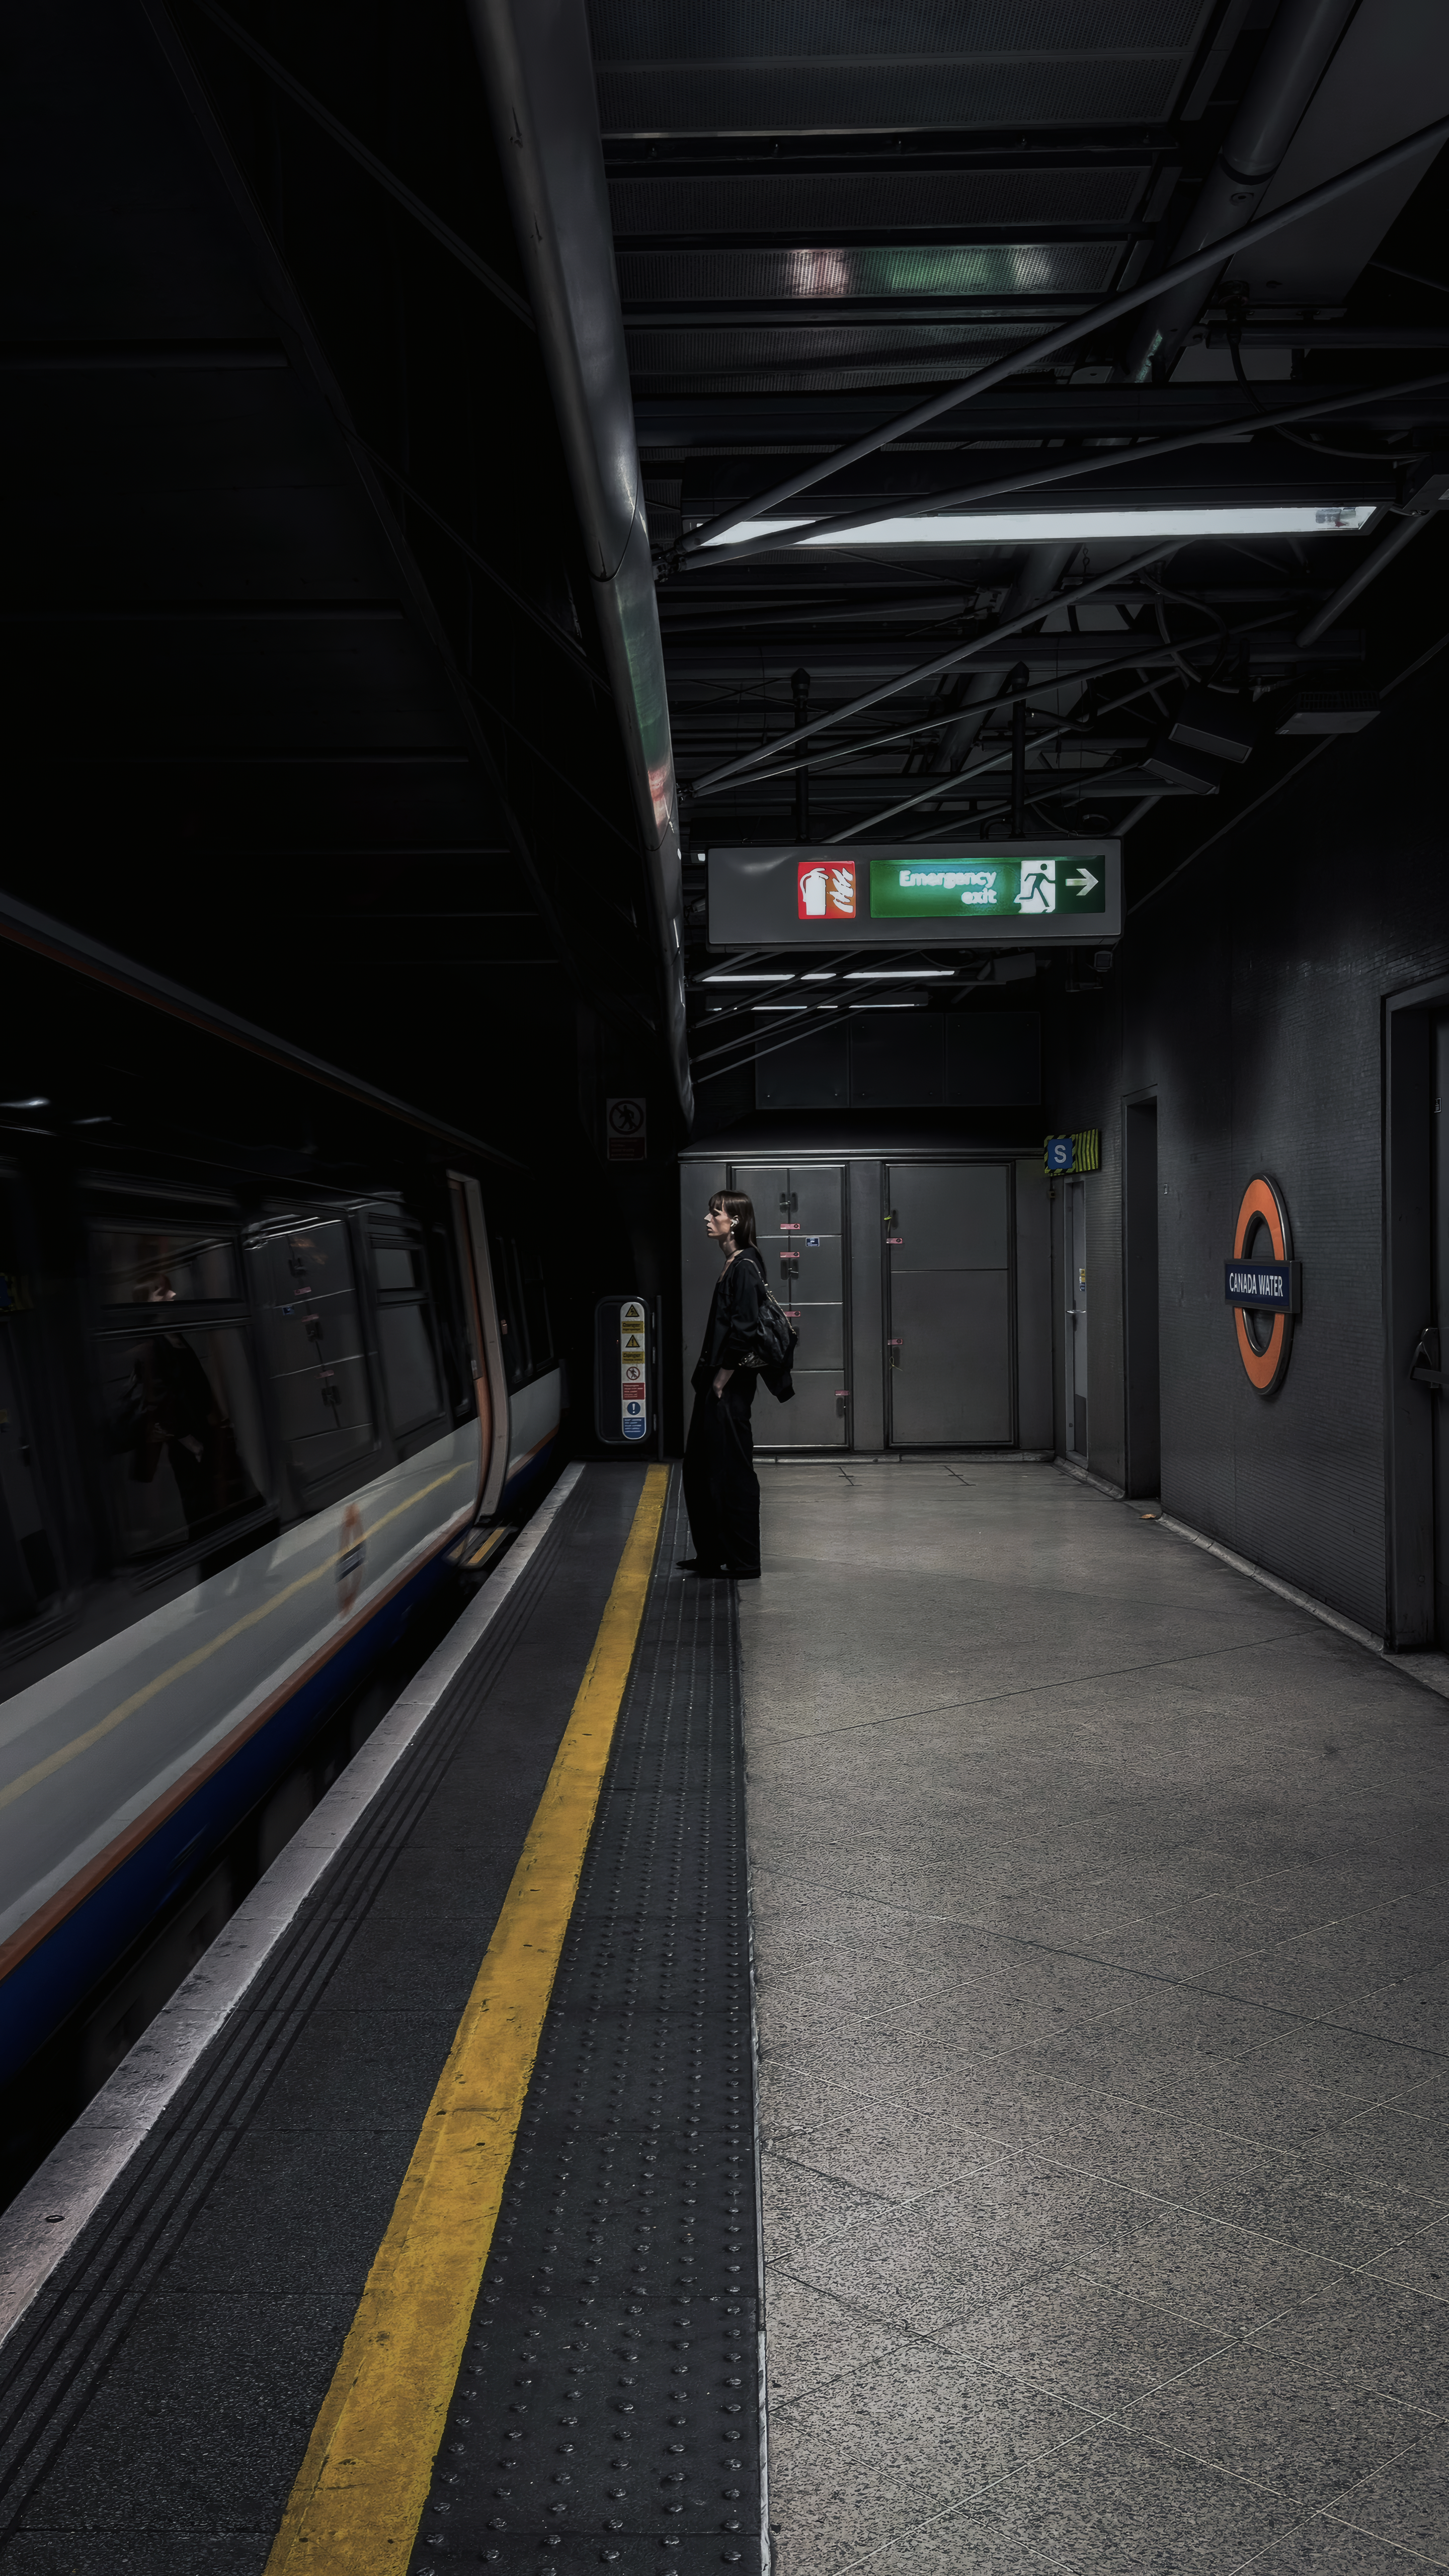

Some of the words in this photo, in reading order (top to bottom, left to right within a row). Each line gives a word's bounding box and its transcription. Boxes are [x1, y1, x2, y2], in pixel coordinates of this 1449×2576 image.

[900, 870, 996, 889] Emergency
[961, 889, 997, 904] exit
[1054, 1145, 1067, 1163] S
[1229, 1272, 1257, 1294] CANADA
[1258, 1274, 1283, 1297] WATER
